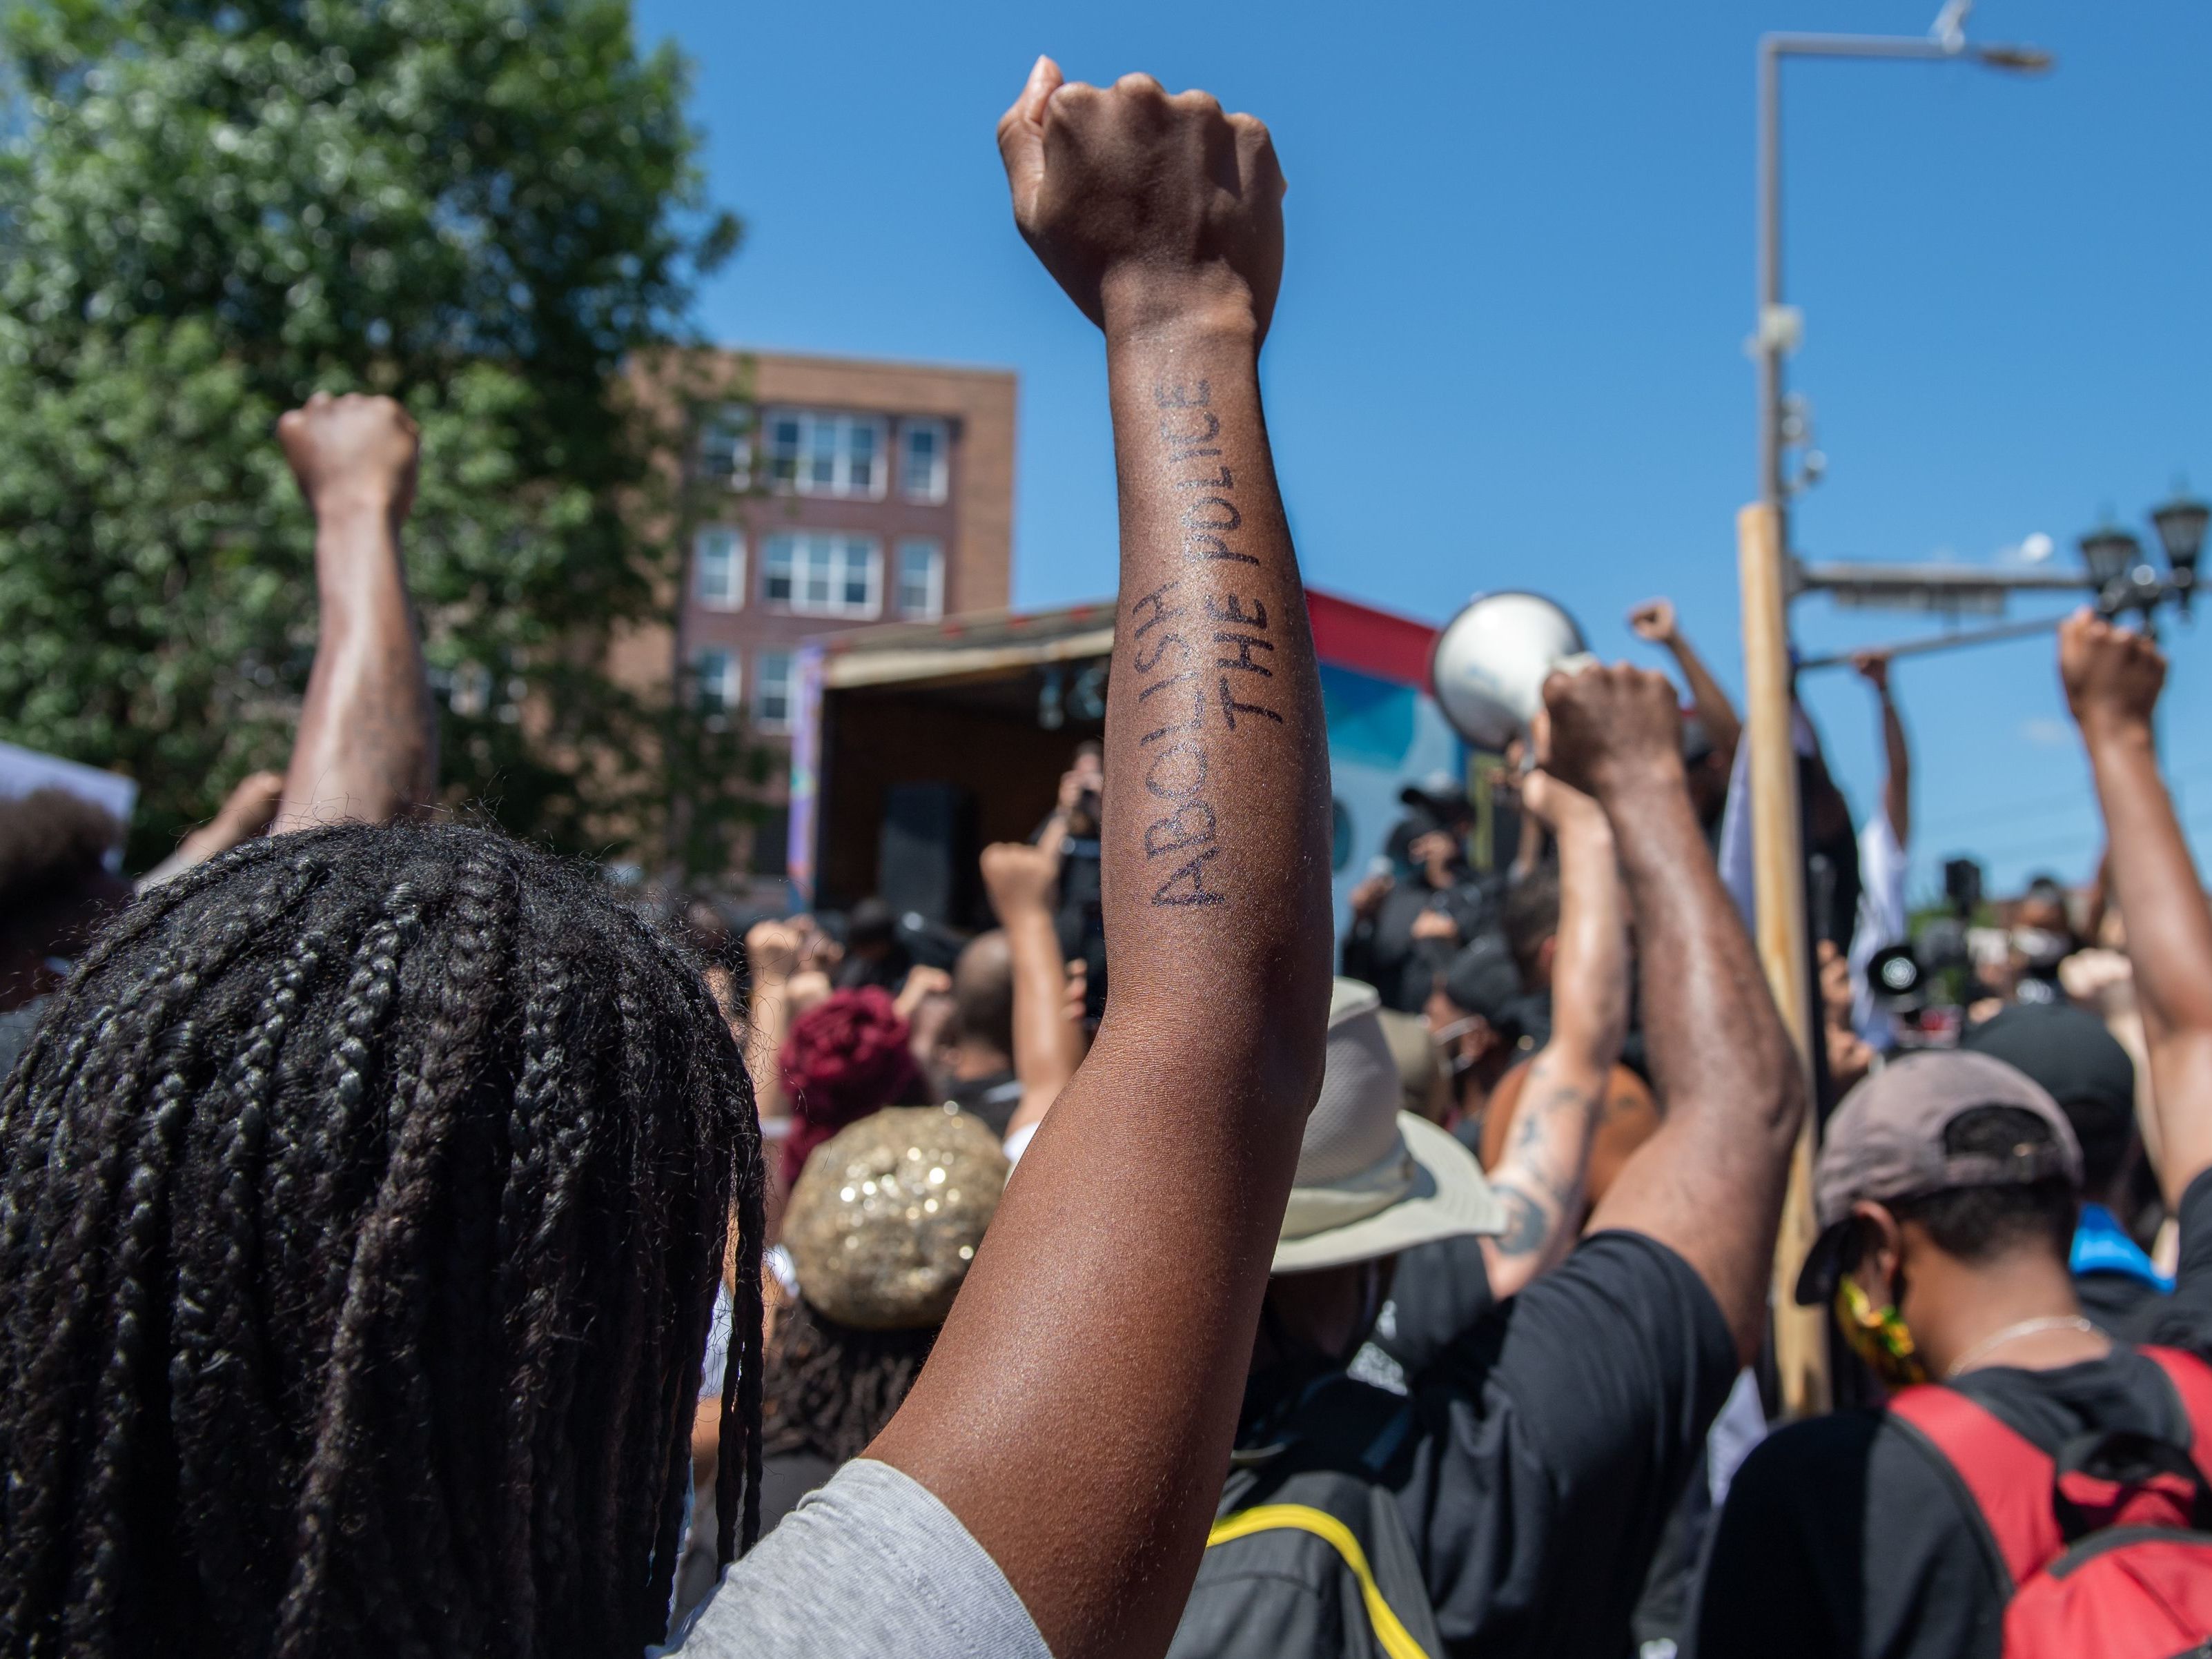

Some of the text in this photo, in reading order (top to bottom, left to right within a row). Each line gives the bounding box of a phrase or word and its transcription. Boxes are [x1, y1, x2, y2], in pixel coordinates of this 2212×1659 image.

[1154, 378, 1284, 731] THE POLICE
[1132, 580, 1225, 907] ABOLISH
